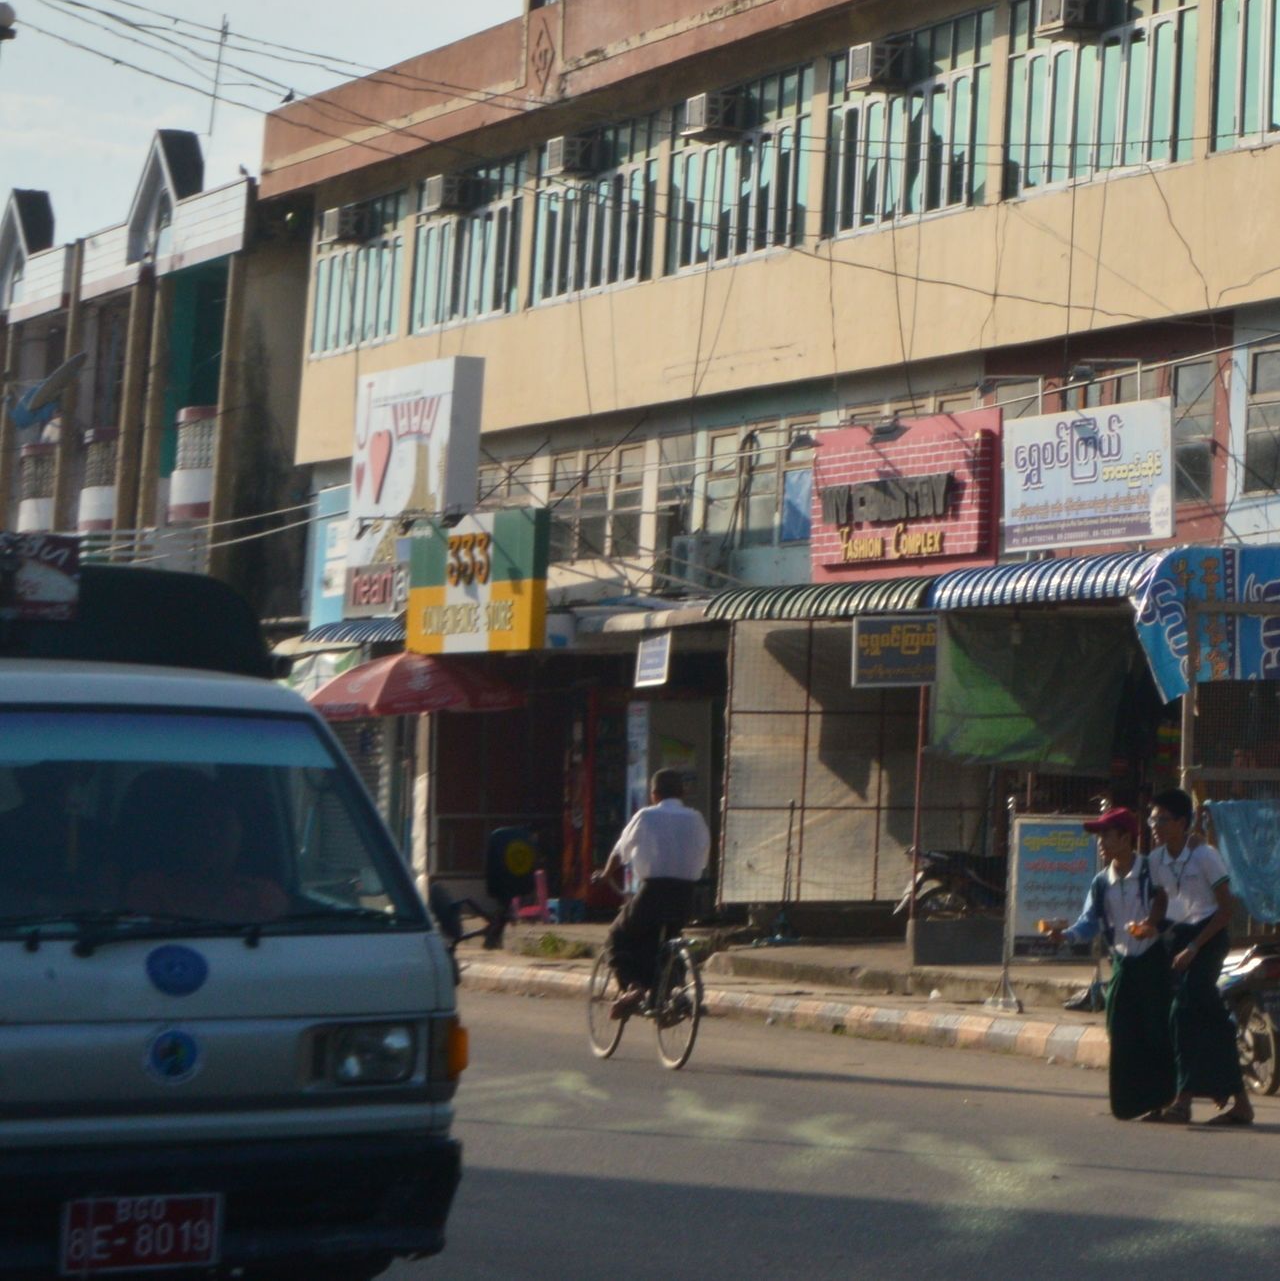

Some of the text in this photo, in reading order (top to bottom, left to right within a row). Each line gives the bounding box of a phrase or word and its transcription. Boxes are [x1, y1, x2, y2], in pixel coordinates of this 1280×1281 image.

[447, 532, 492, 586] 333
[352, 566, 392, 606] heart
[422, 599, 514, 636] CONVENIENCE STORE
[115, 1198, 167, 1223] BGO
